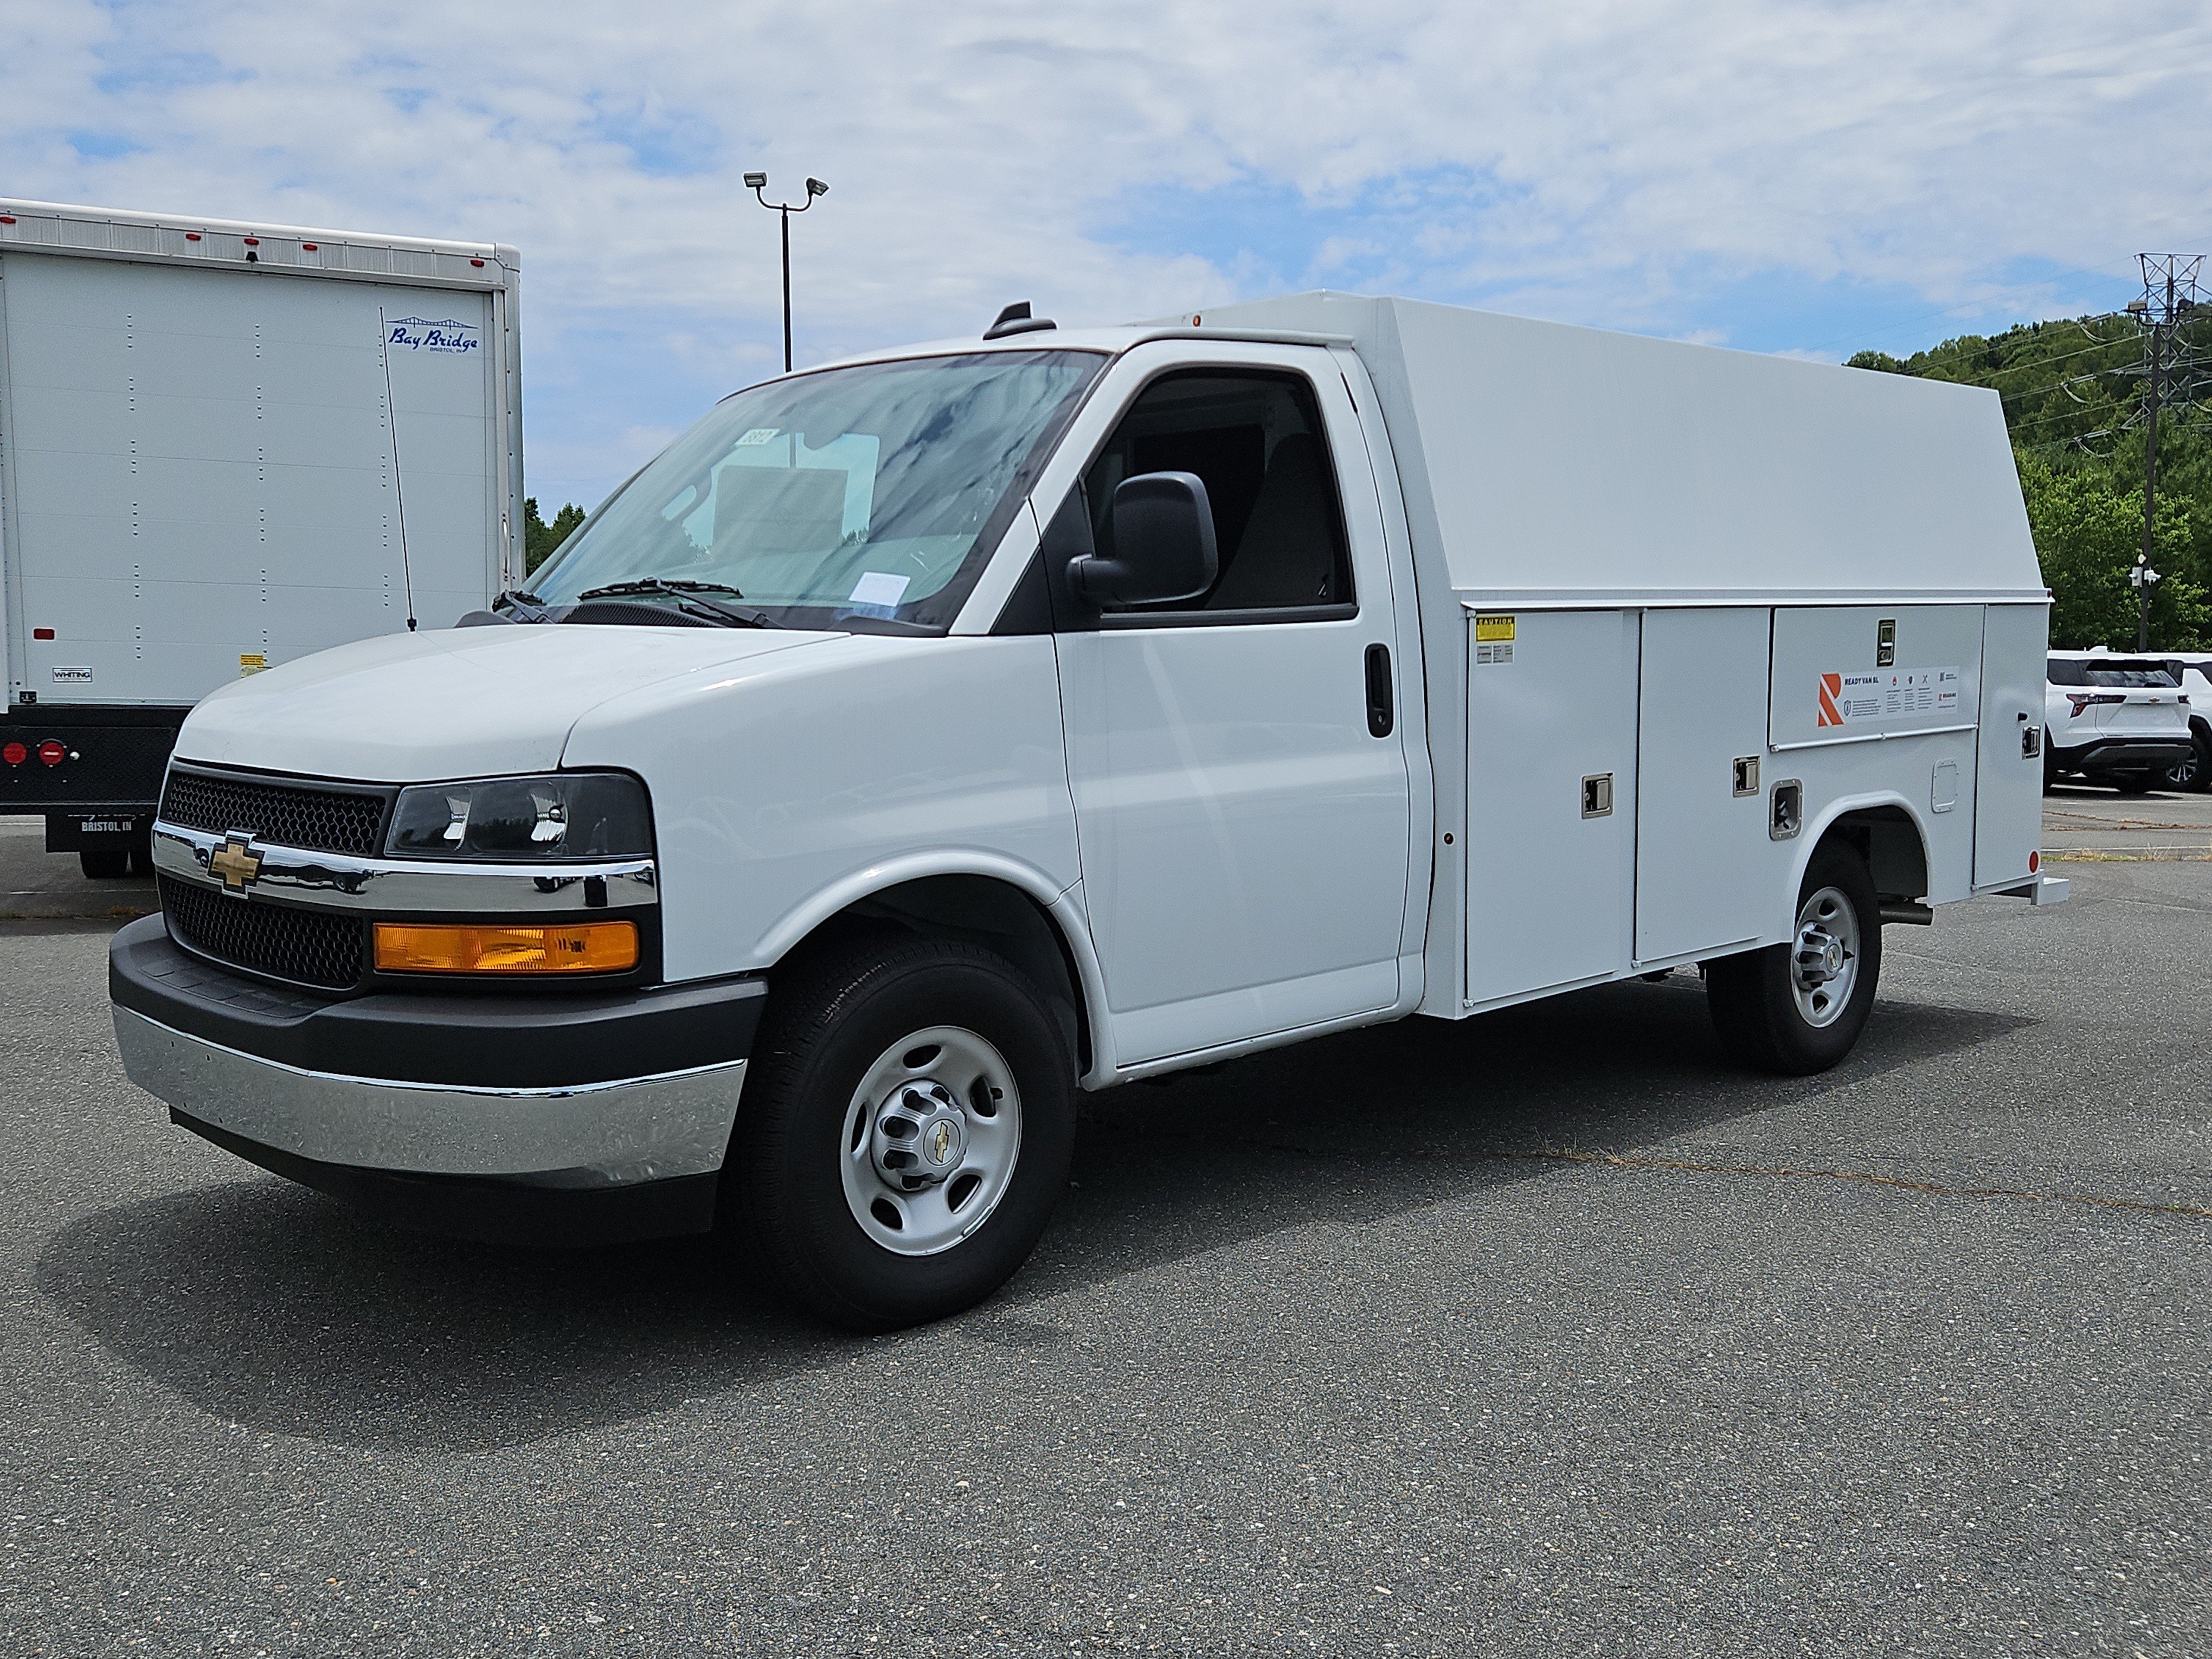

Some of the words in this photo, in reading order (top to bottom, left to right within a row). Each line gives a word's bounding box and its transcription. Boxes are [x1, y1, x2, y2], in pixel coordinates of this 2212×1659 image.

[388, 327, 421, 350] Bay
[422, 330, 478, 352] Bridge
[123, 821, 131, 831] IN
